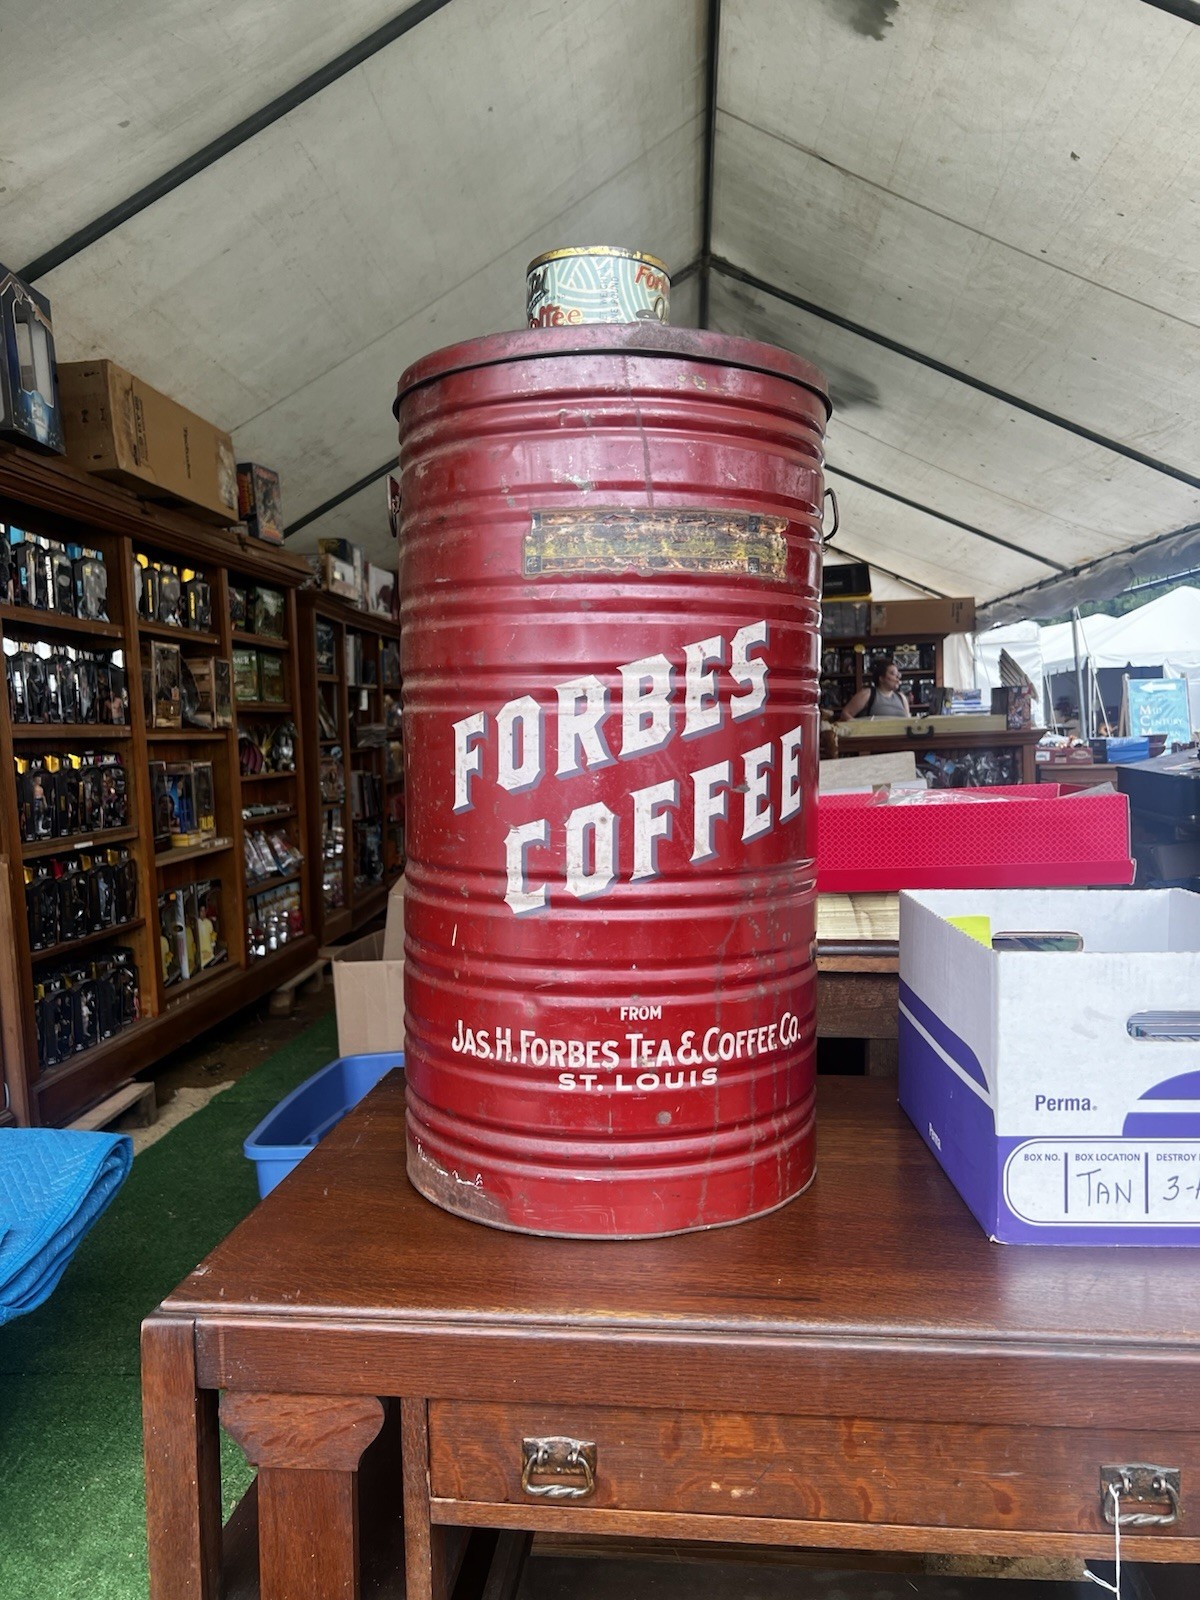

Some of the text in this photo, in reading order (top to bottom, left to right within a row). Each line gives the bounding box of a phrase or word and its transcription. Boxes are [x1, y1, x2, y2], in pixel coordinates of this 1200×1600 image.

[452, 619, 770, 815] FORBES
[1139, 715, 1183, 727] CENTURY
[503, 725, 802, 918] COFFEE
[620, 1005, 662, 1021] FROM
[520, 1029, 620, 1069] FORBES
[625, 1033, 675, 1068] TEA
[677, 1030, 703, 1065] &
[702, 1026, 778, 1062] COFFEE
[779, 1012, 801, 1046] CO.
[558, 1067, 719, 1092] ST. LOUIS
[1035, 1094, 1092, 1111] Perma
[1024, 1153, 1061, 1162] BOX NO.
[1075, 1153, 1141, 1162] BOX LOCATION
[1156, 1153, 1196, 1162] DESTROY
[1076, 1168, 1132, 1207] TAN
